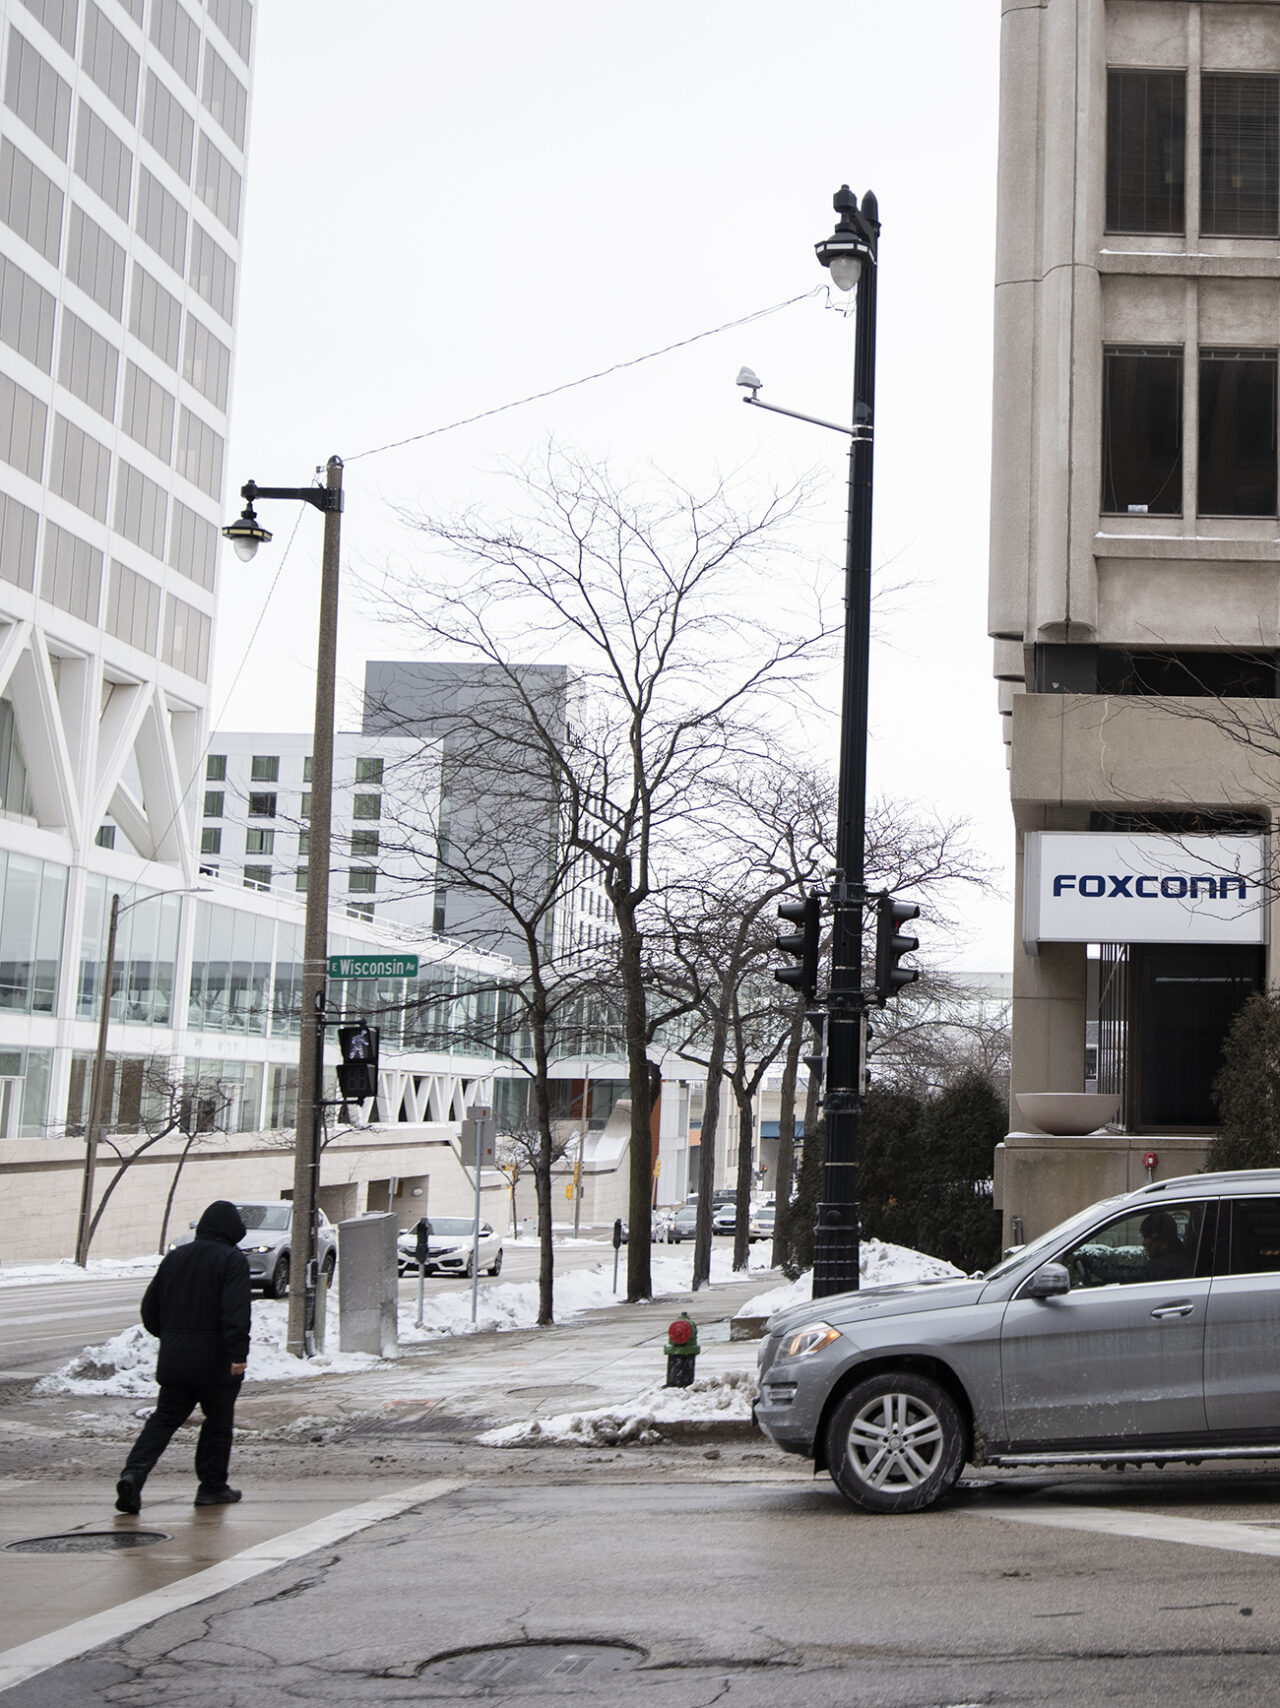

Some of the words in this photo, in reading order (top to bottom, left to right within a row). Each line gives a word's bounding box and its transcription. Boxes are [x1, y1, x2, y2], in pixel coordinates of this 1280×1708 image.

[332, 963, 337, 971] E
[340, 959, 404, 975] Wisconsin
[406, 962, 415, 971] Av
